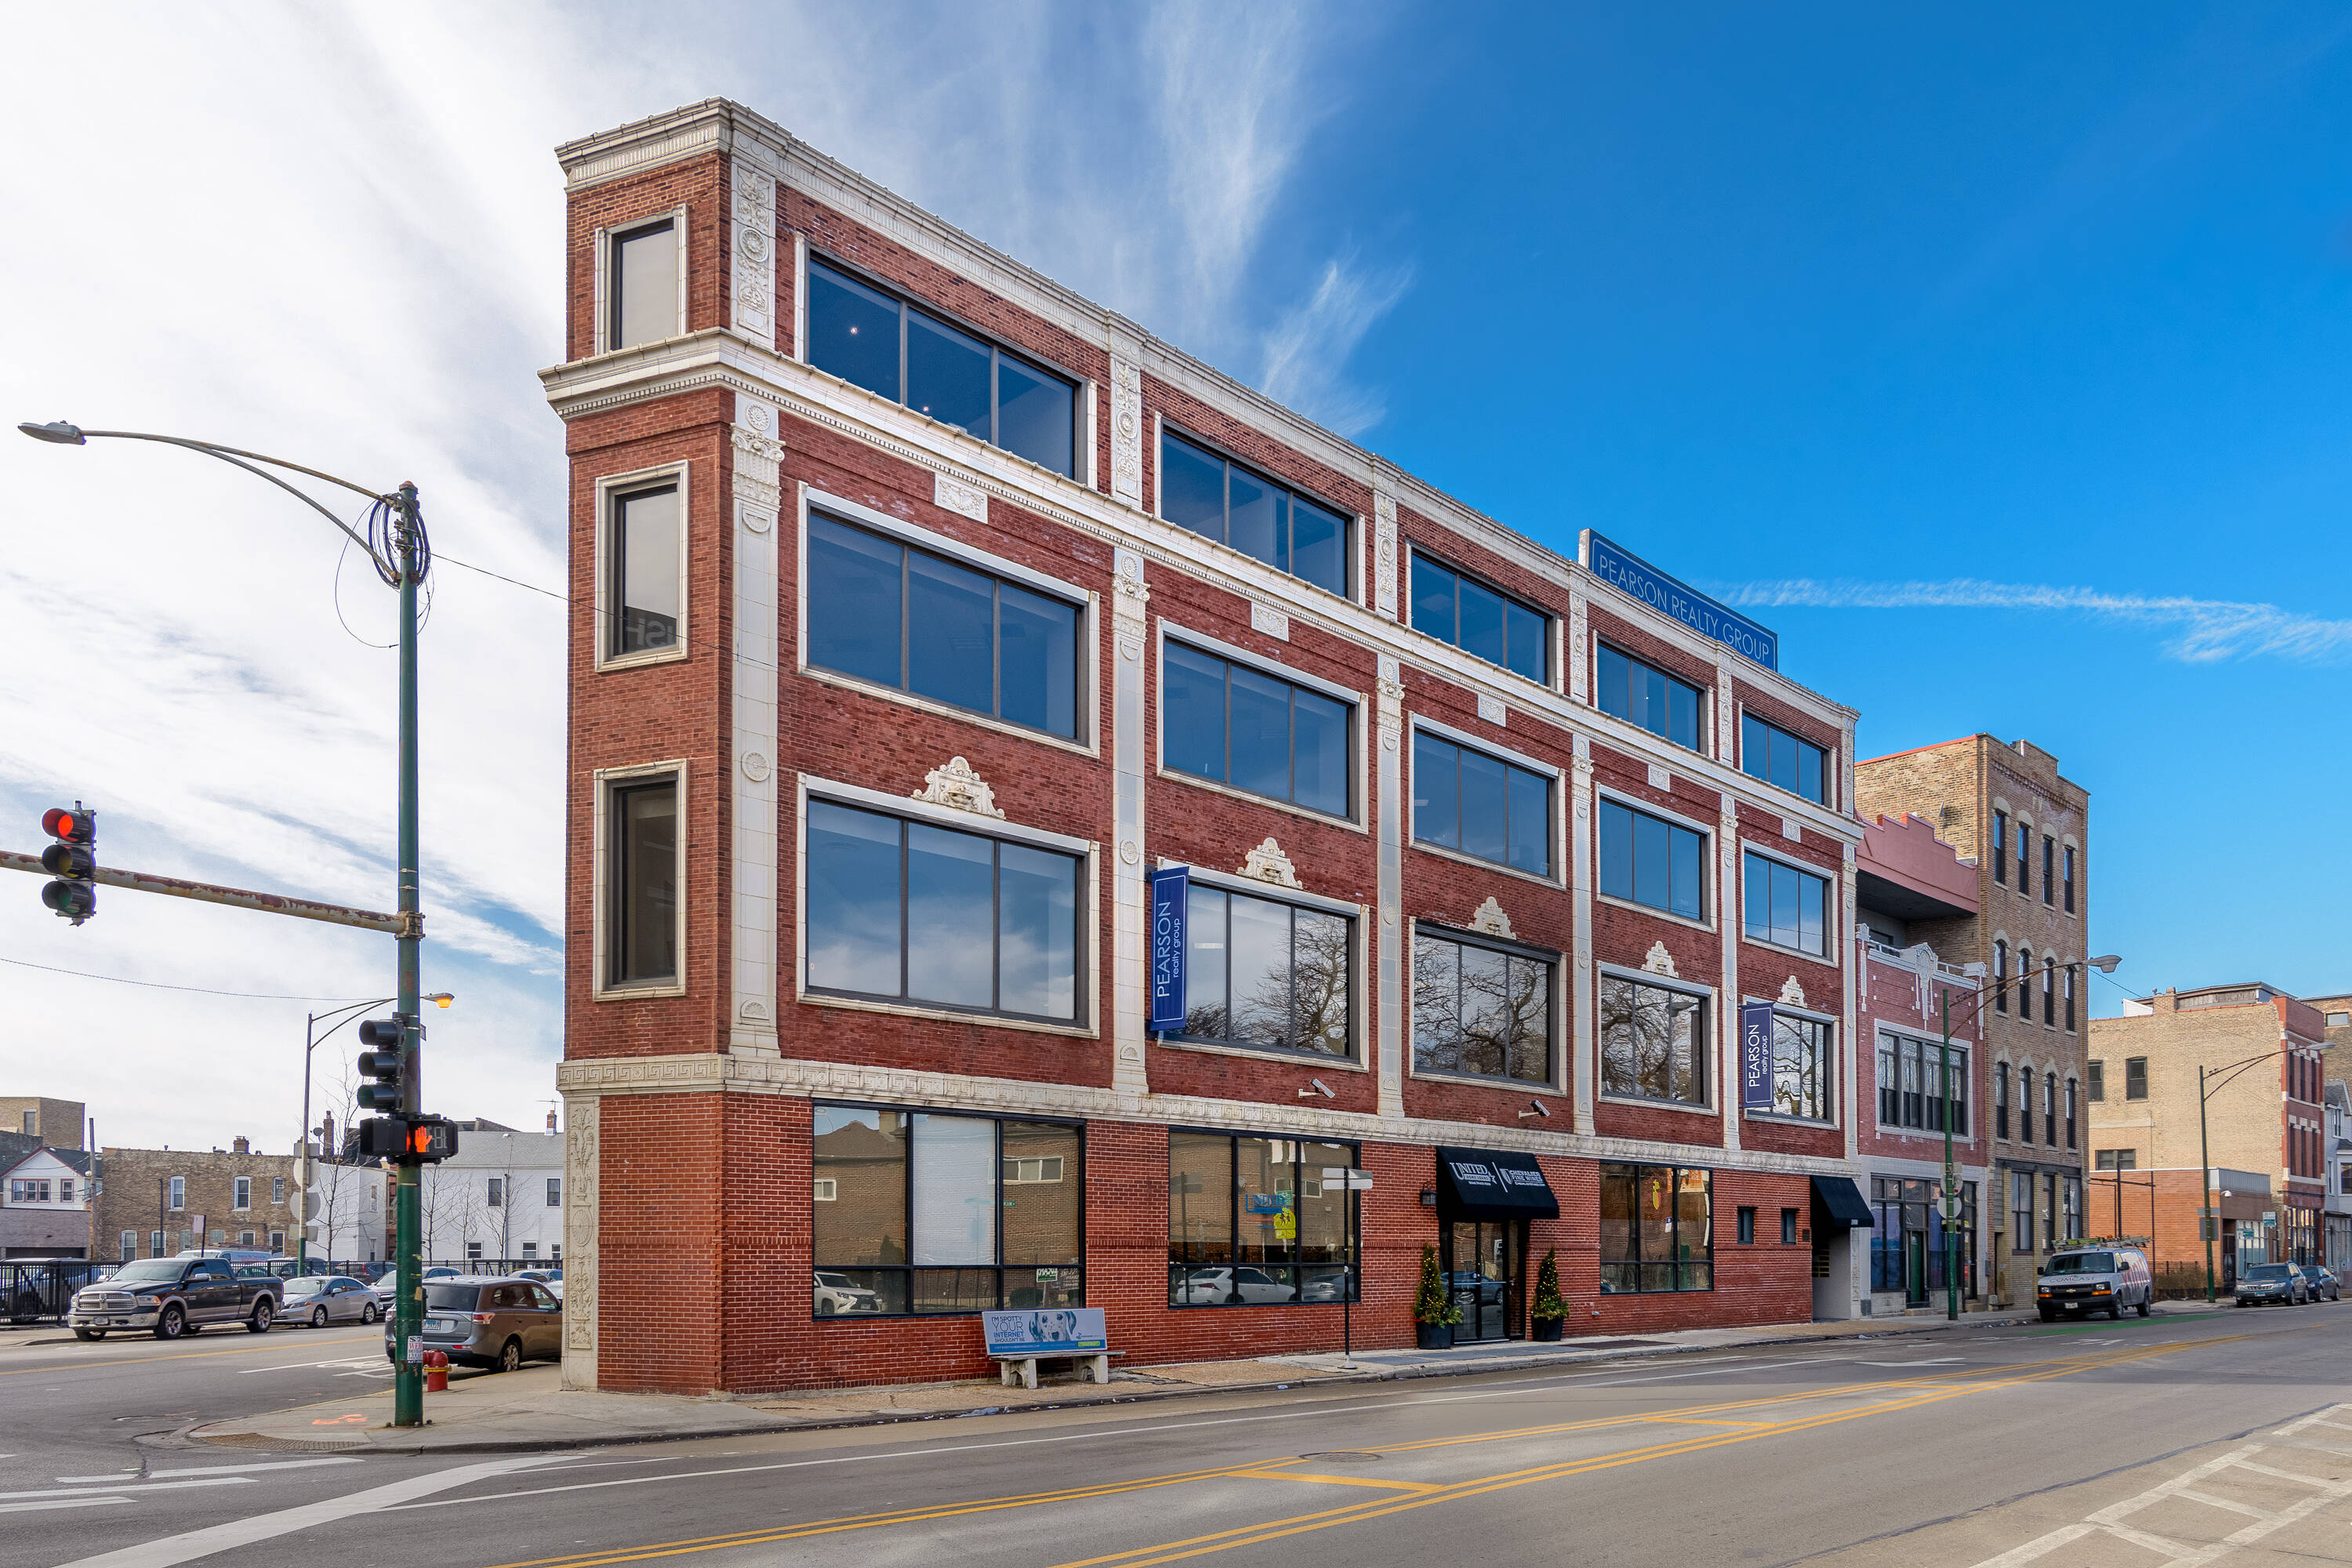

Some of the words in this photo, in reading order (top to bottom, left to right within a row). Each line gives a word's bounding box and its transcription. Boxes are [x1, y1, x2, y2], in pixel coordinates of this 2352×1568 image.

[1599, 554, 1668, 612] PEARSON
[1671, 594, 1719, 638] REALTY
[1722, 622, 1769, 662] GROUP
[1173, 918, 1181, 949] group
[1157, 902, 1171, 997] PEARSON
[1172, 950, 1181, 978] realty
[1748, 1024, 1760, 1087] PEARSON
[1449, 1162, 1488, 1180] UNITED
[992, 1322, 1024, 1332] YOUR
